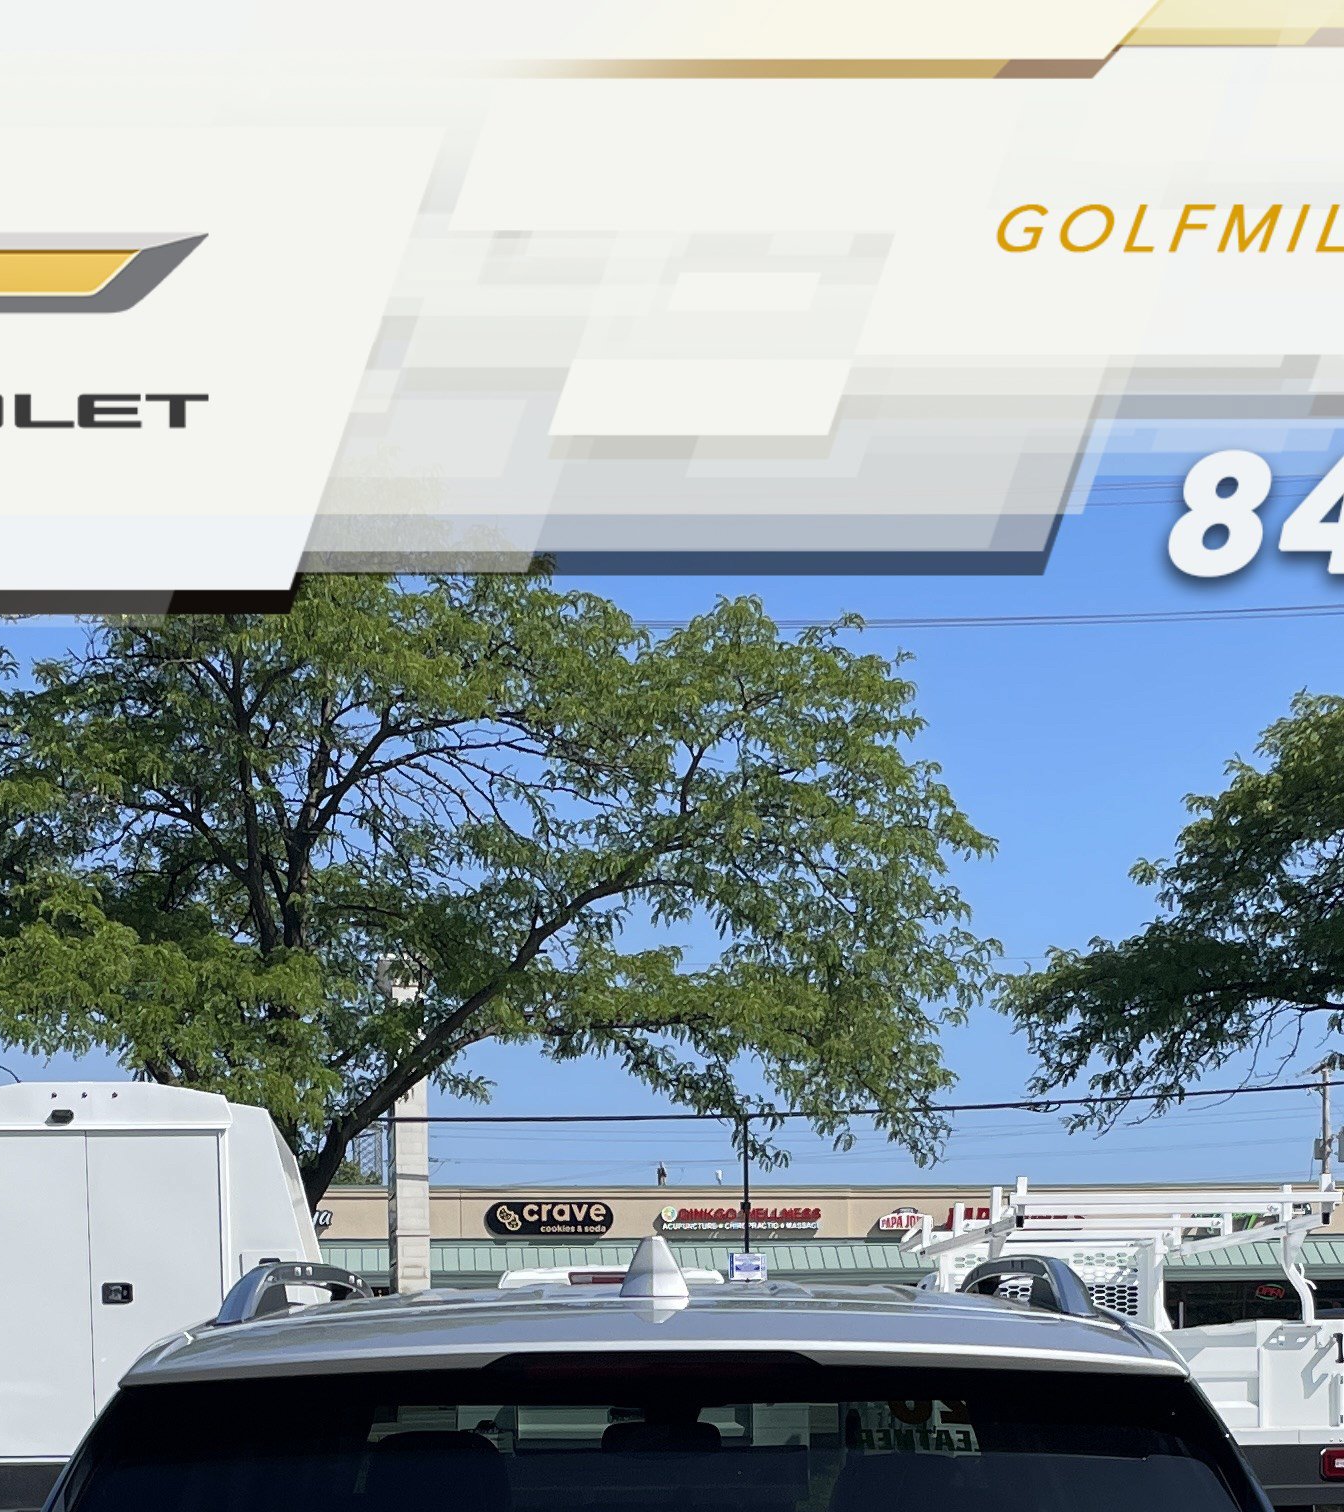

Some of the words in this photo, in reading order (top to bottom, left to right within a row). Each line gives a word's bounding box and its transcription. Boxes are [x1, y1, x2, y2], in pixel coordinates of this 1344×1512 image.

[522, 1203, 607, 1222] crave
[540, 1224, 575, 1233] cookies
[584, 1225, 607, 1233] soda
[881, 1215, 903, 1229] PAPA
